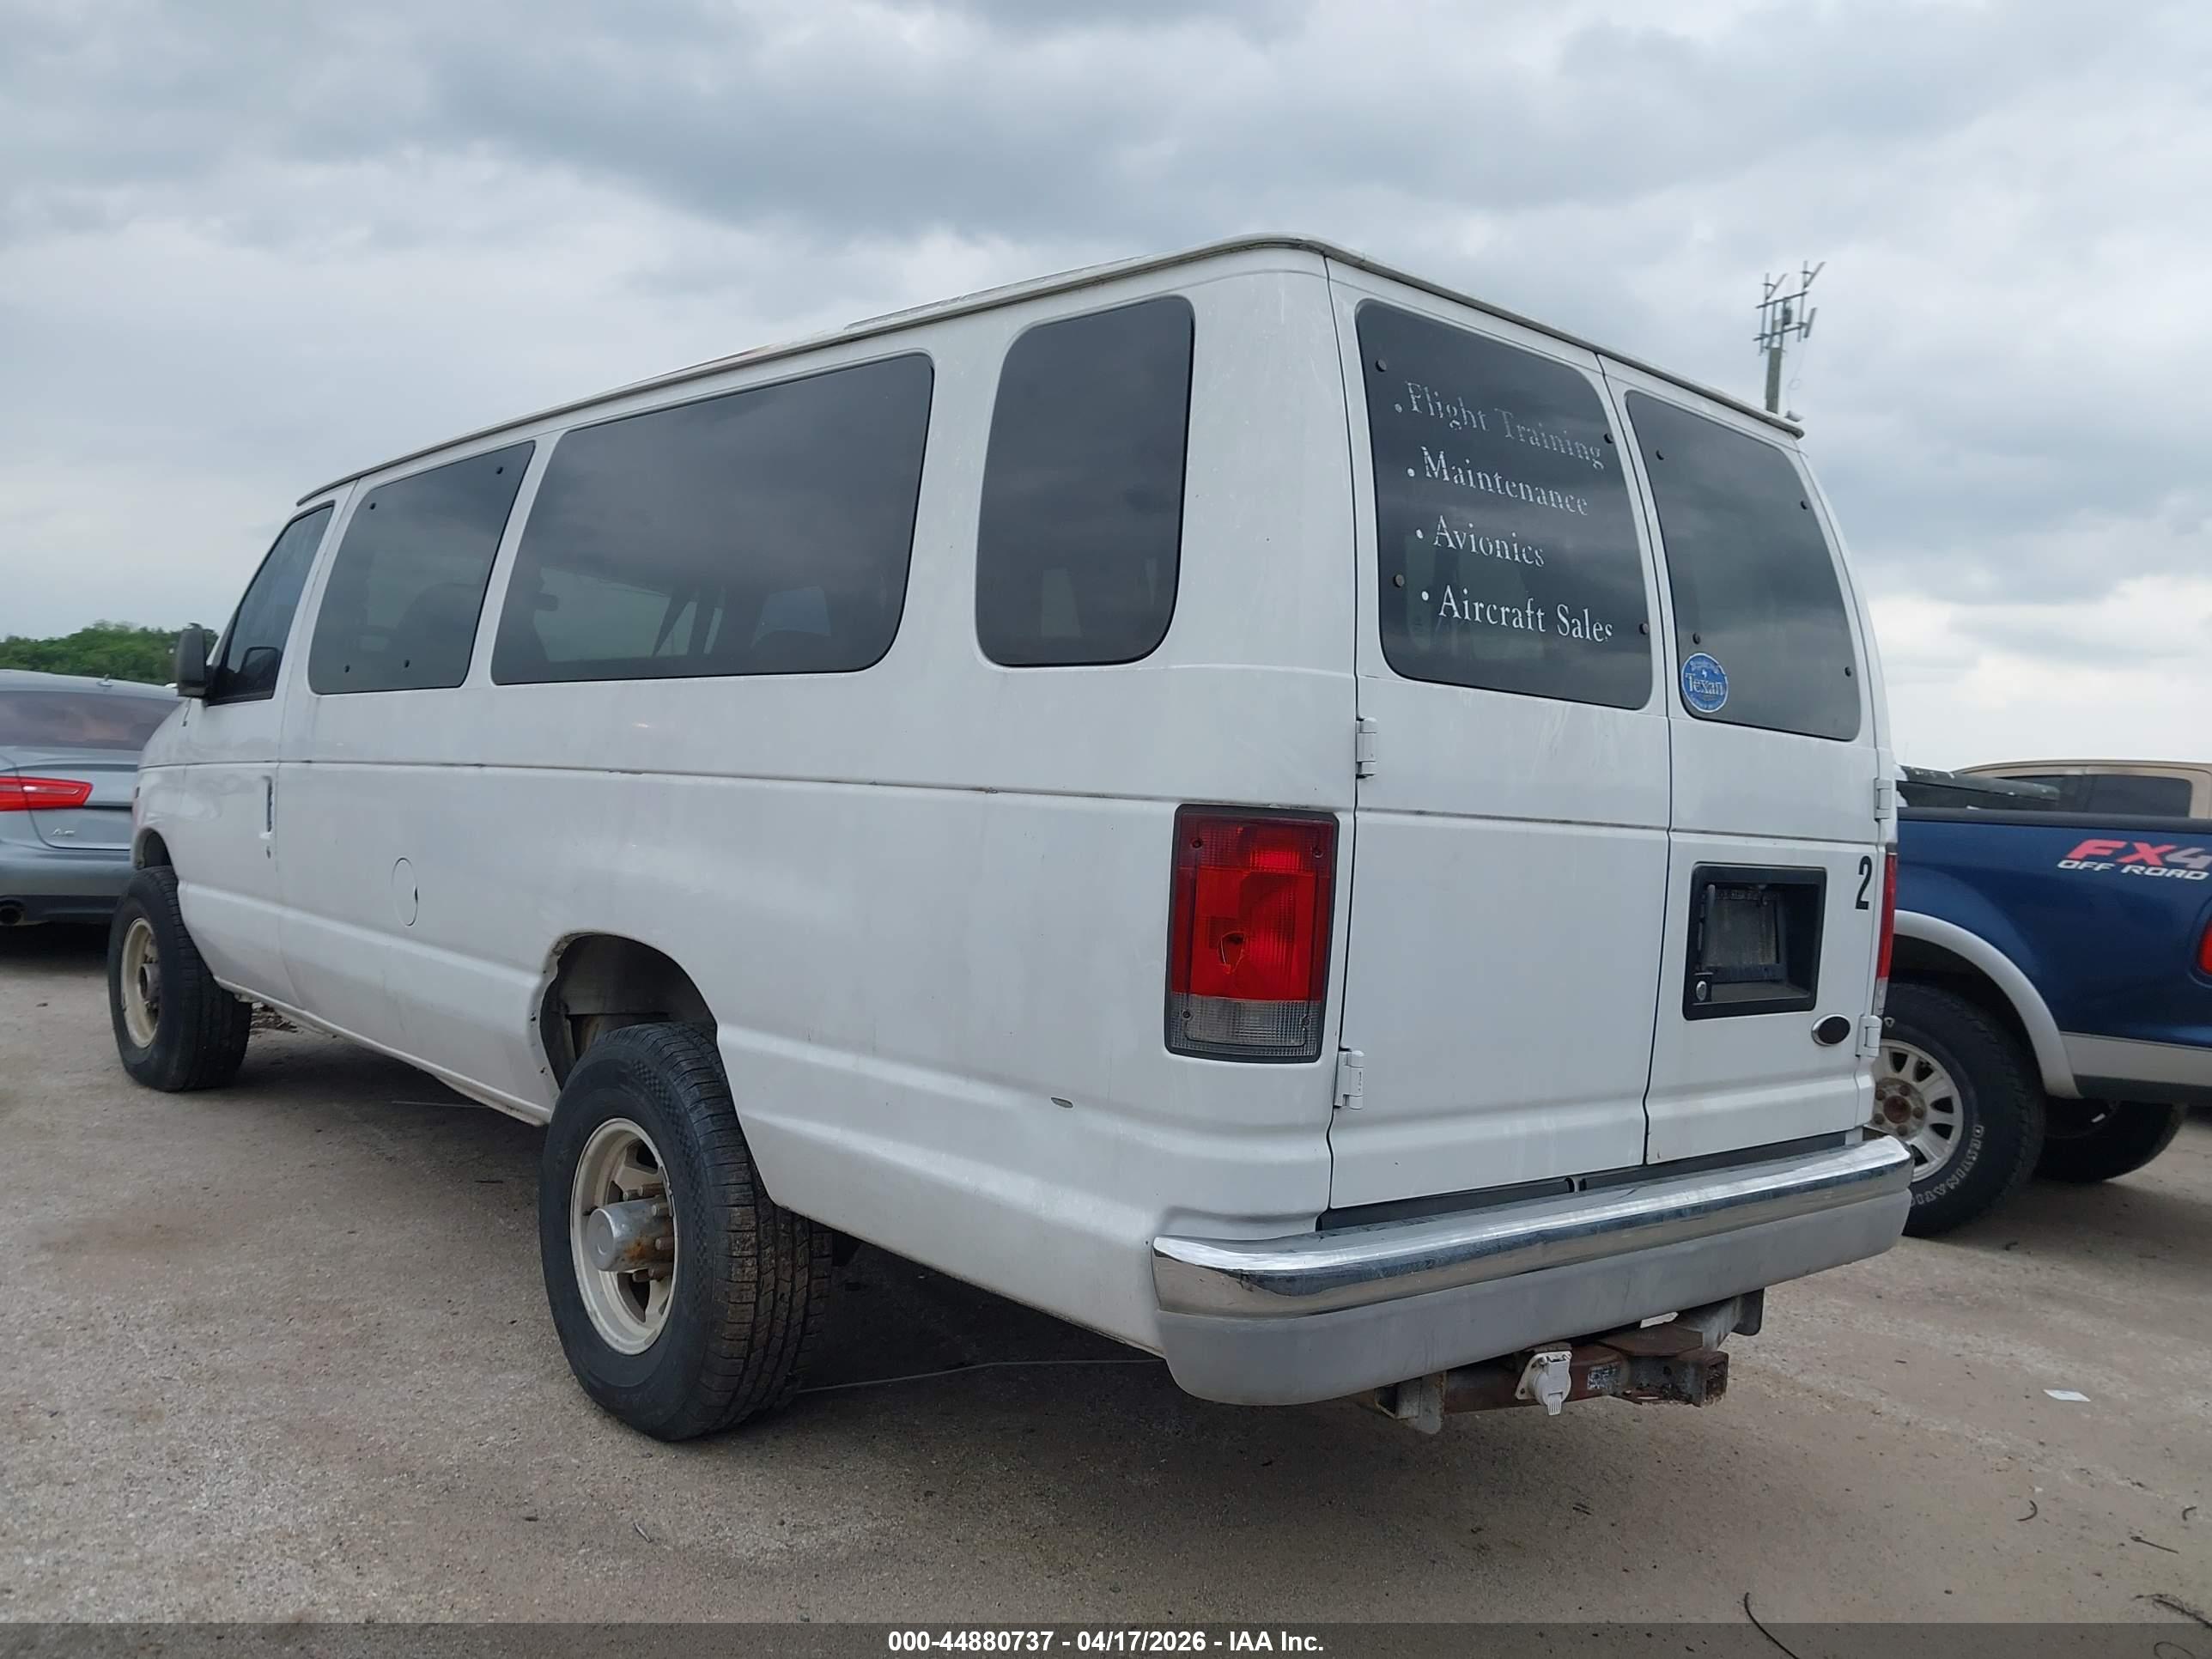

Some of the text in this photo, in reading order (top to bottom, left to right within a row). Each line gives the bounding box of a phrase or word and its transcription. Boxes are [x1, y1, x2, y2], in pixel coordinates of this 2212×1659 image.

[1405, 381, 1604, 471] Flight Training
[1421, 446, 1589, 516] Maintenance
[1433, 514, 1545, 568] Avionics
[1438, 585, 1613, 642] Aircraft Sales
[1685, 672, 1723, 696] Texan
[2057, 860, 2209, 880] OFF ROAD
[2065, 838, 2212, 870] FX4
[1855, 855, 1873, 909] 2
